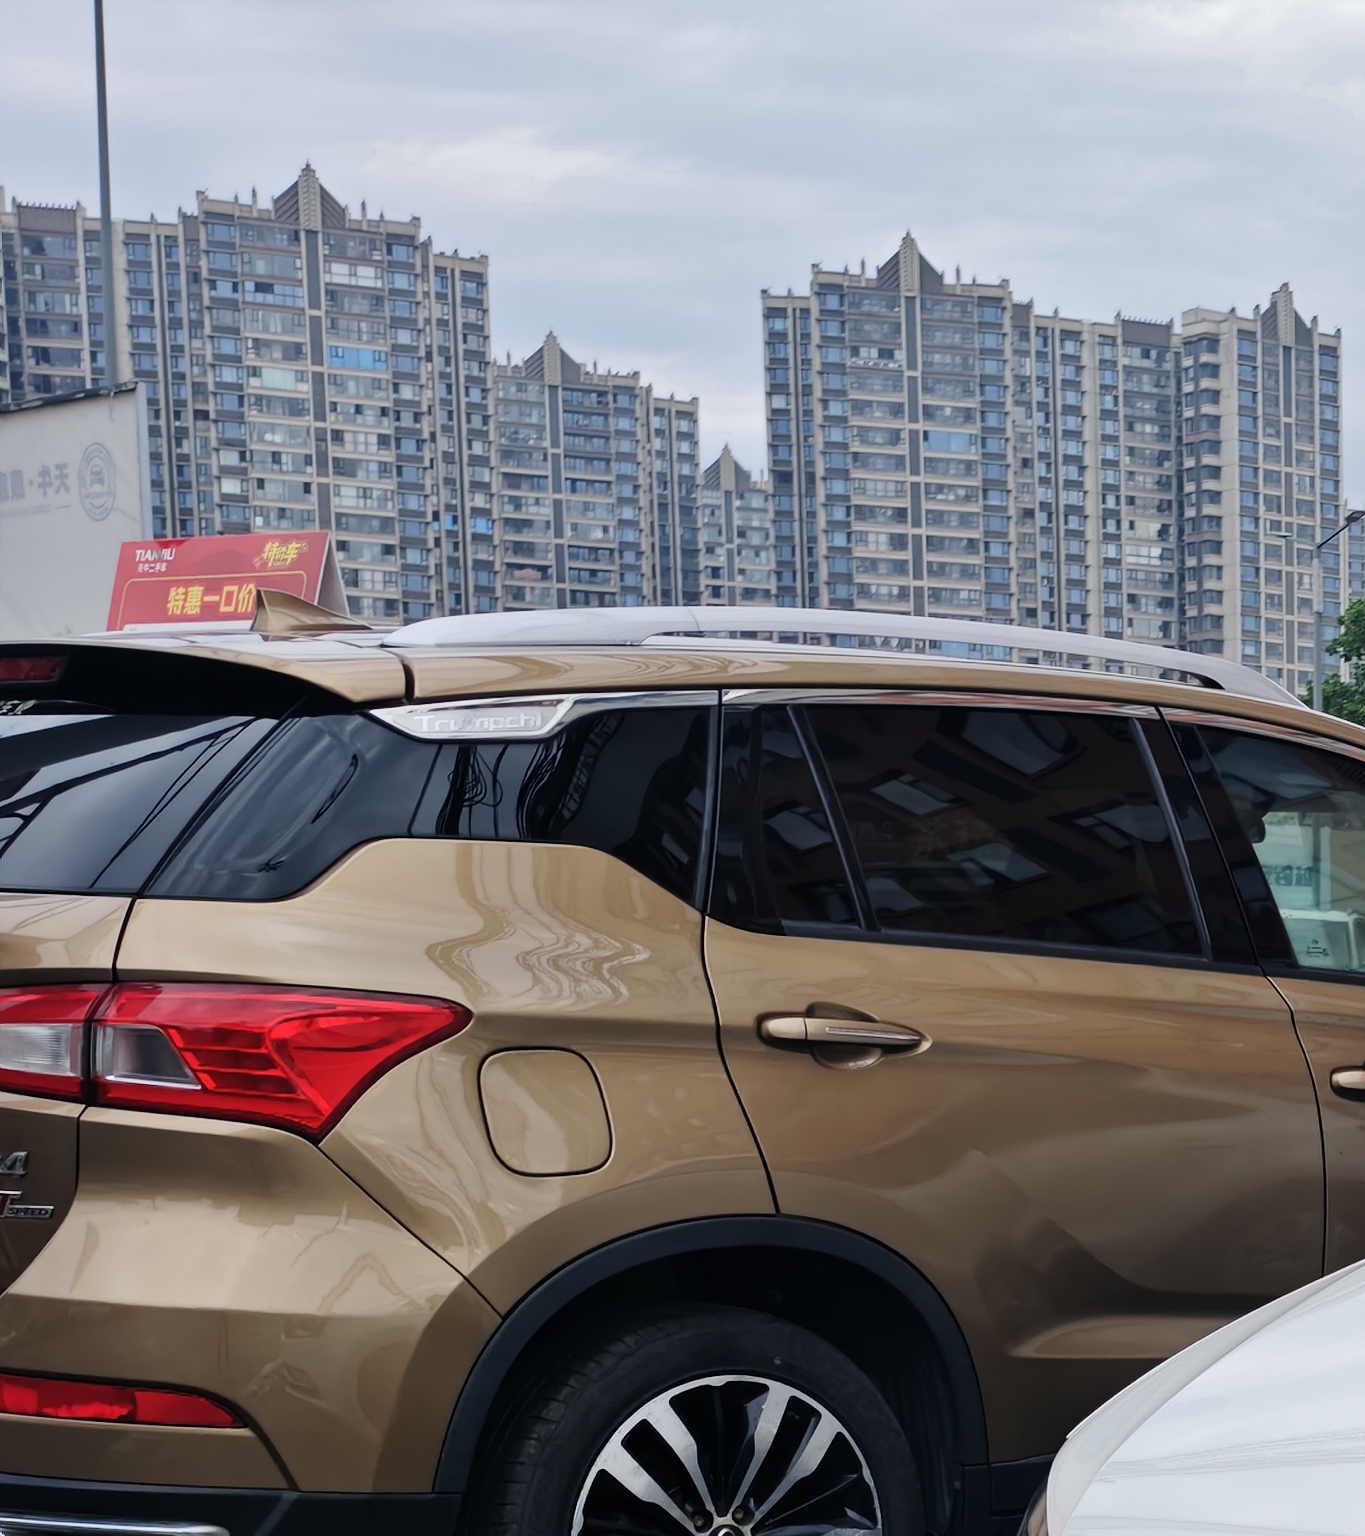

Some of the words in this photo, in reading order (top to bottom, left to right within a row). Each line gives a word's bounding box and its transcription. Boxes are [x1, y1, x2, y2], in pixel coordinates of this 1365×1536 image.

[167, 583, 256, 616] 特惠一口价
[413, 711, 542, 732] Trumpchi
